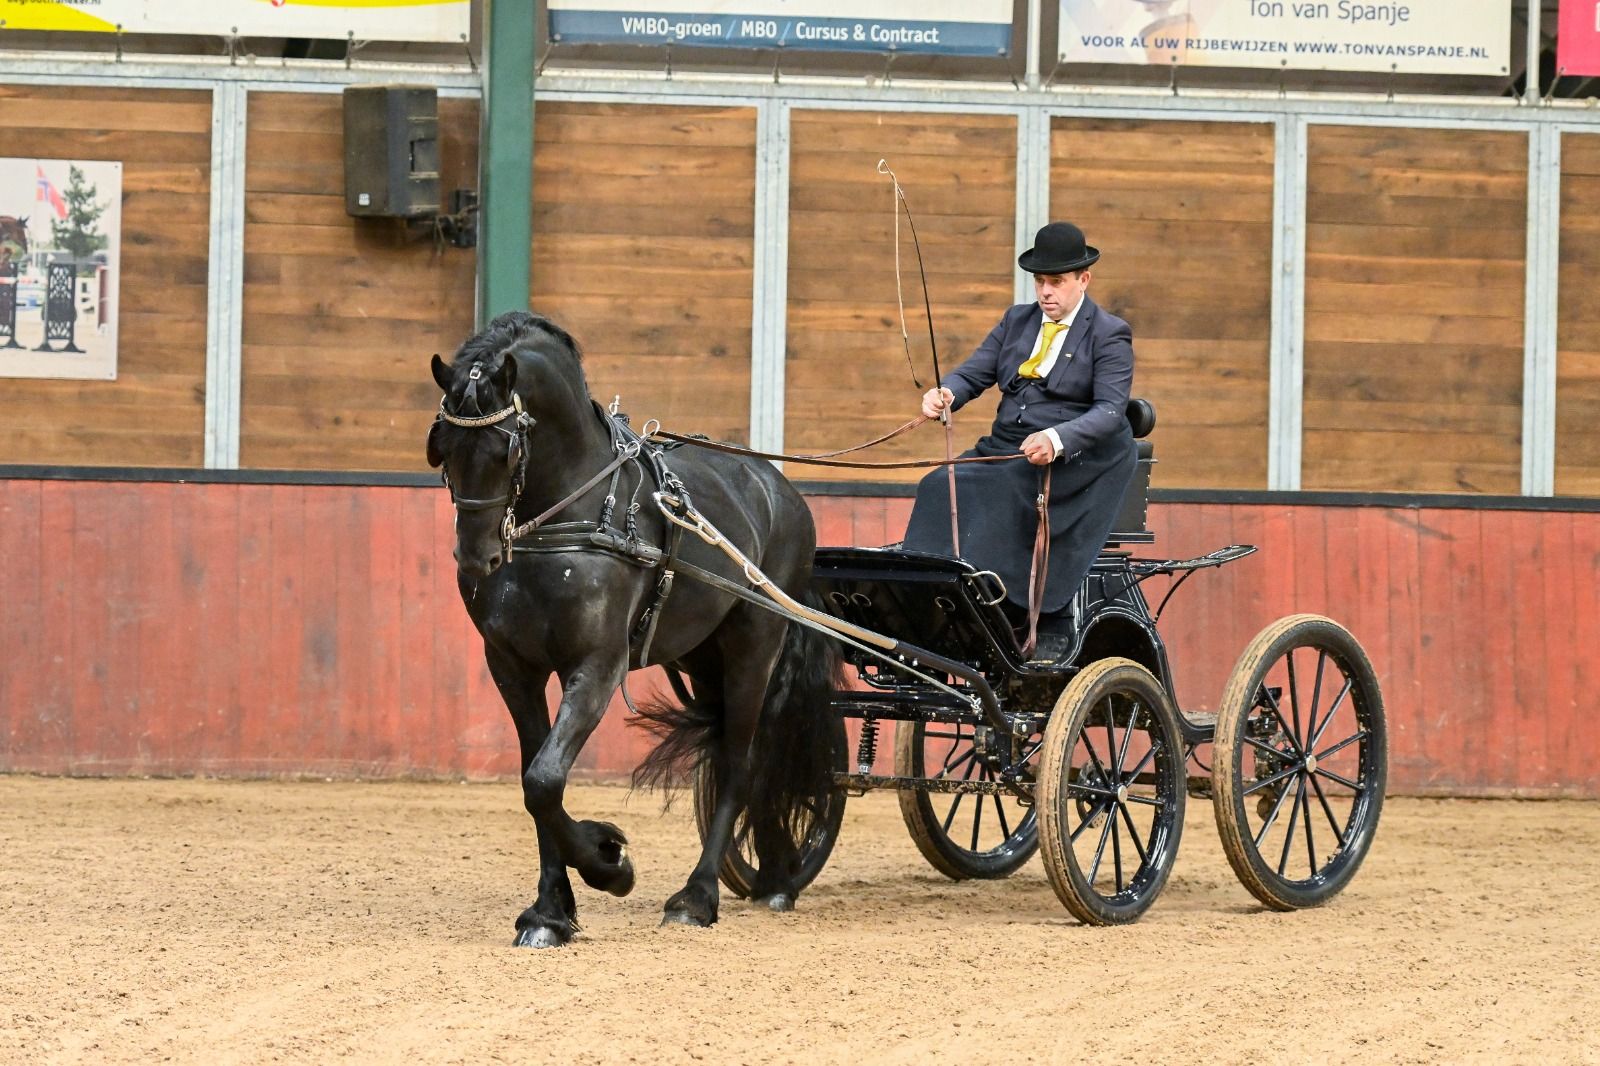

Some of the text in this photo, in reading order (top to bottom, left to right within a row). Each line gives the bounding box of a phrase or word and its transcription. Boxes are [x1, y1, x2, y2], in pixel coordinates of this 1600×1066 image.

[1293, 4, 1329, 19] van
[1338, 0, 1410, 26] Spanje
[622, 17, 722, 39] VMBO-groen
[741, 21, 777, 38] MBO
[796, 22, 849, 40] Cursus
[853, 24, 865, 40] &
[870, 25, 939, 43] Contract
[1082, 36, 1489, 58] VOOR AL UW RIJBEWIJZEN WWW.TONVANSPANJE.NL
